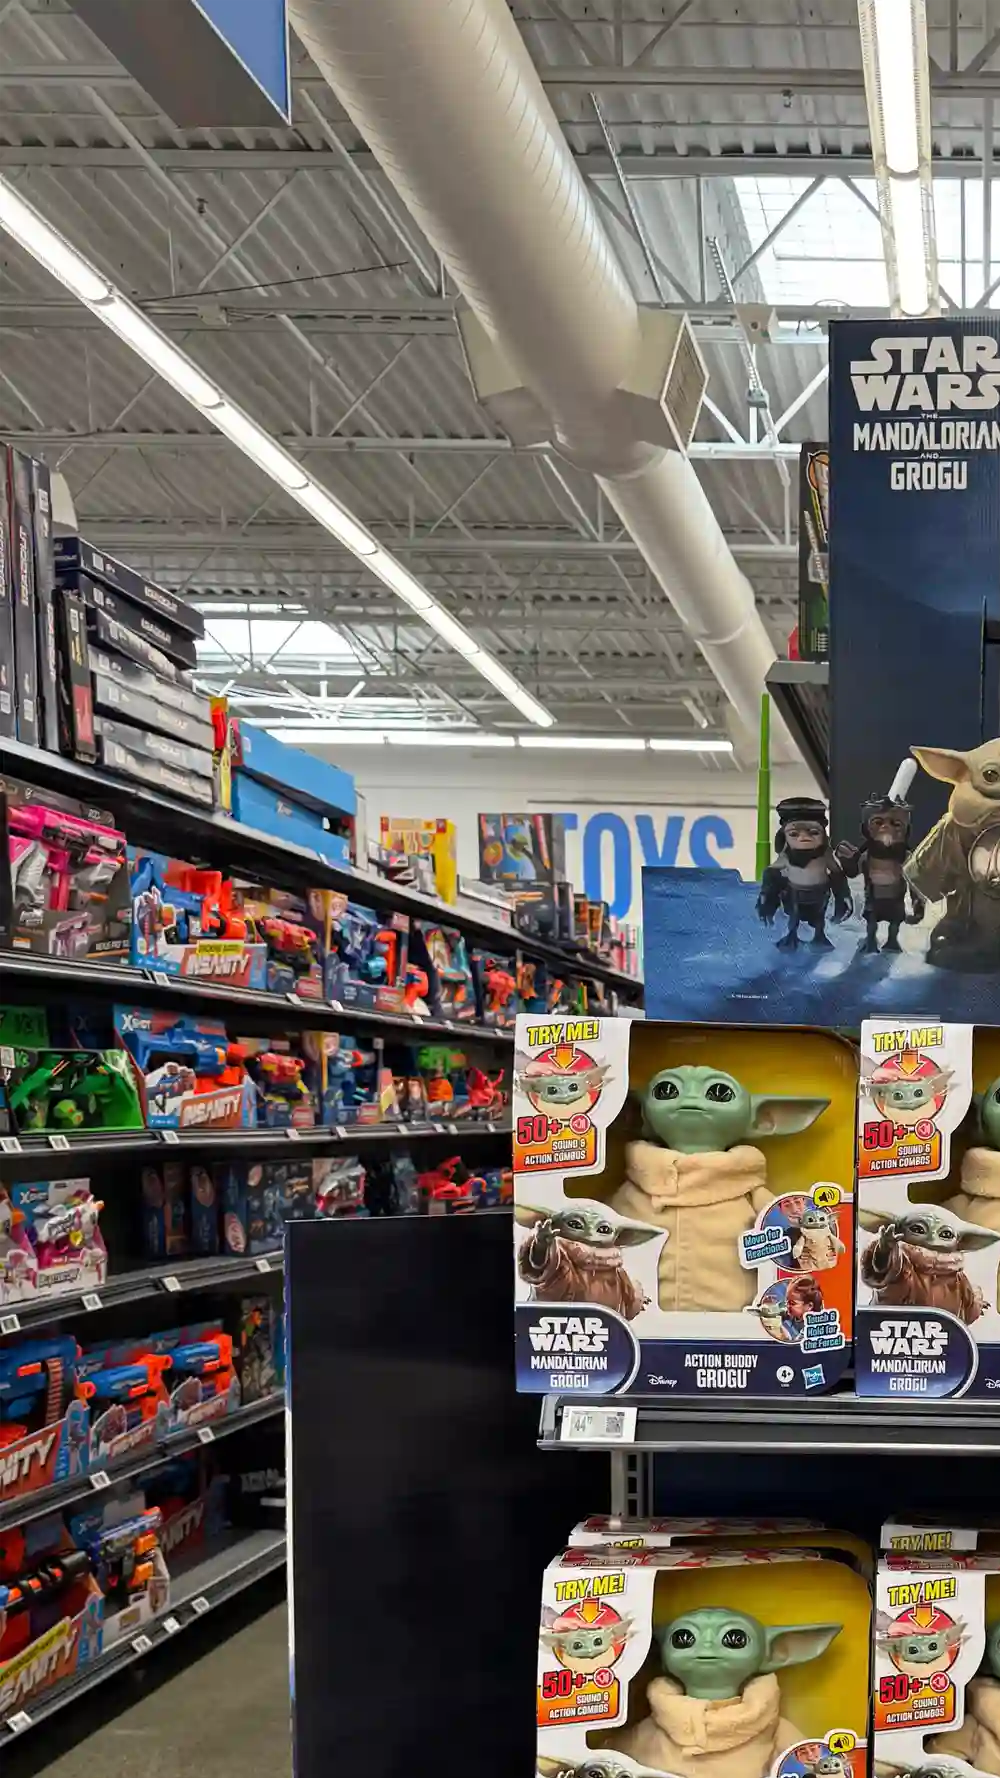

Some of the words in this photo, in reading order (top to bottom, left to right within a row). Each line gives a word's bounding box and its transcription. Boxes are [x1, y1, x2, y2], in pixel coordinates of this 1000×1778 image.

[891, 461, 967, 490] GROGU
[527, 1026, 563, 1046] TRY
[567, 1020, 599, 1041] ME!
[516, 1115, 562, 1144] 50+
[552, 1140, 577, 1150] SOUND
[525, 1153, 552, 1165] ACTION
[553, 1150, 586, 1161] COMBOS
[746, 1242, 788, 1261] Reactions!
[529, 1317, 608, 1335] STAR
[870, 1322, 948, 1339] STAR
[530, 1334, 608, 1352] WARS
[870, 1338, 948, 1355] WARS
[531, 1356, 607, 1369] MANDALORIAN
[685, 1354, 721, 1367] ACTION
[724, 1354, 758, 1368] BUDDY
[871, 1360, 946, 1373] MANDALORIAN
[550, 1375, 589, 1388] GROGU
[648, 1373, 677, 1388] Disney
[889, 1377, 927, 1390] GROGU
